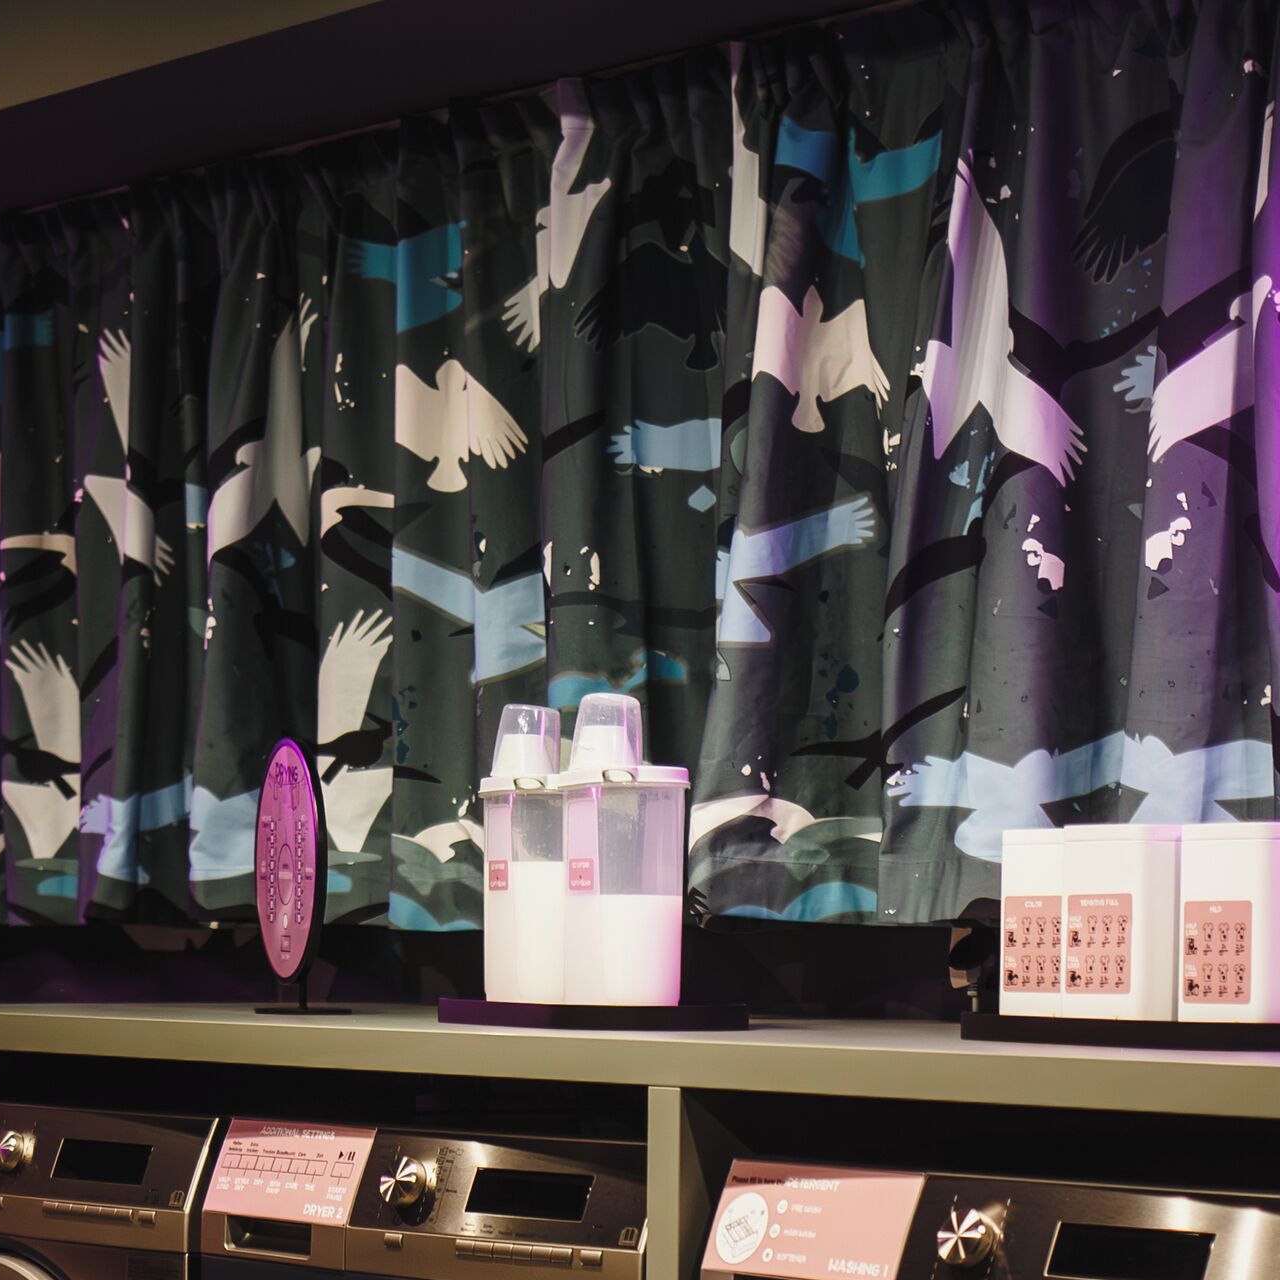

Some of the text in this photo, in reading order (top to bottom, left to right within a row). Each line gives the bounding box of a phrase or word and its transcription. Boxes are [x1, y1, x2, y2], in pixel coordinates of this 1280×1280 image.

[260, 1126, 336, 1140] ADDITIONAL SETTINGS
[785, 1176, 841, 1192] DETERGENT
[303, 1204, 344, 1219] DRYER 2
[827, 1257, 881, 1277] WASHING
